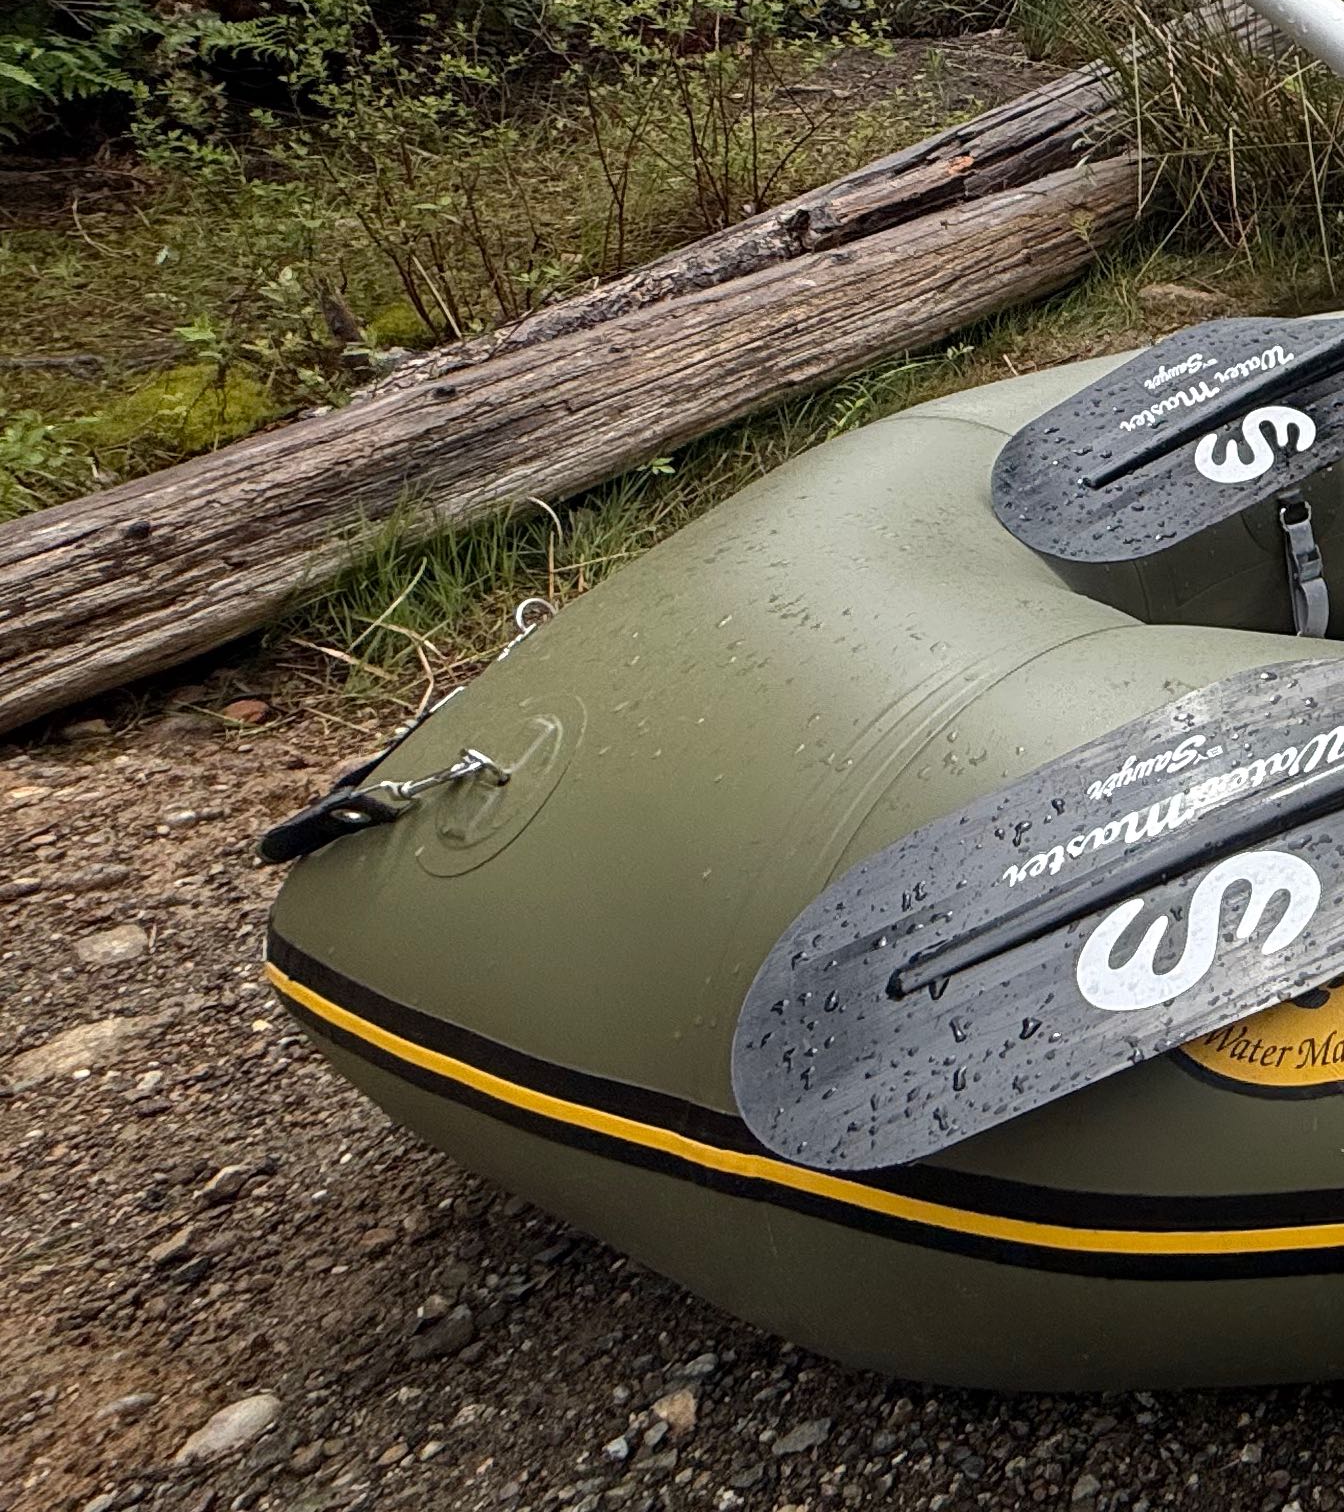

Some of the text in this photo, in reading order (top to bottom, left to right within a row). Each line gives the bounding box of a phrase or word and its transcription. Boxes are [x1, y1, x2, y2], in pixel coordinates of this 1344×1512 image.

[1119, 345, 1295, 432] Water Master
[1087, 734, 1207, 800] Sawyer
[1003, 788, 1205, 888] Master
[1204, 1024, 1293, 1068] Water
